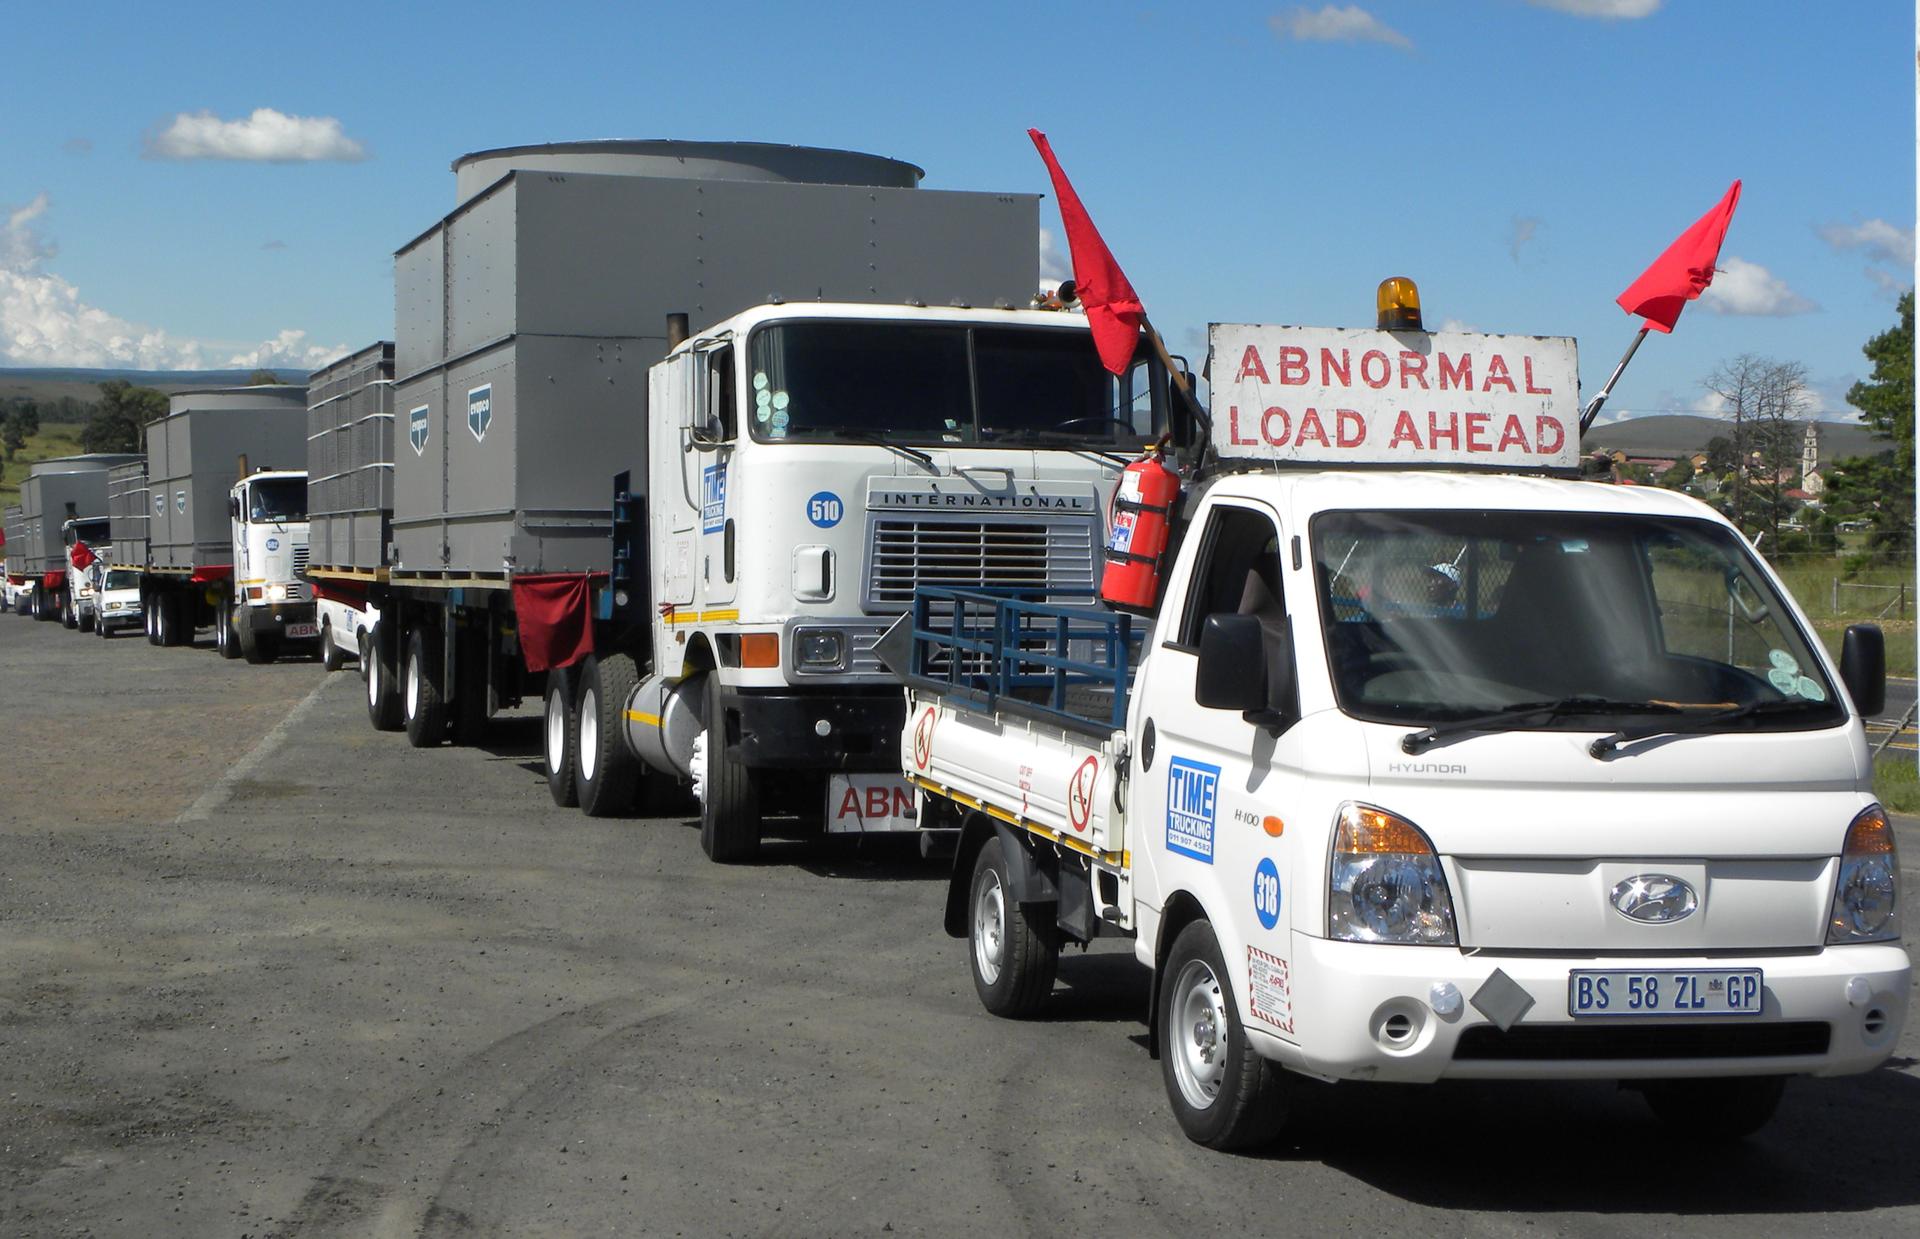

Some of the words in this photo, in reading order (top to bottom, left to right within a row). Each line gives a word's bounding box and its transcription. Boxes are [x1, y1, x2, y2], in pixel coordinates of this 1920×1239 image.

[1234, 344, 1552, 395] ABNORMAL
[1230, 405, 1367, 448] LOAD
[1388, 410, 1565, 455] AHEAD
[811, 500, 839, 521] 510
[884, 493, 1082, 508] INTERNATIONAL
[1389, 763, 1467, 774] HYUNDAI
[1171, 767, 1215, 819] TIME
[1169, 812, 1212, 842] TRUCKING
[1256, 871, 1279, 917] 318
[1577, 976, 1610, 1009] BS
[1628, 976, 1659, 1009] 58
[1674, 976, 1705, 1009] ZL
[1727, 975, 1757, 1008] GP
